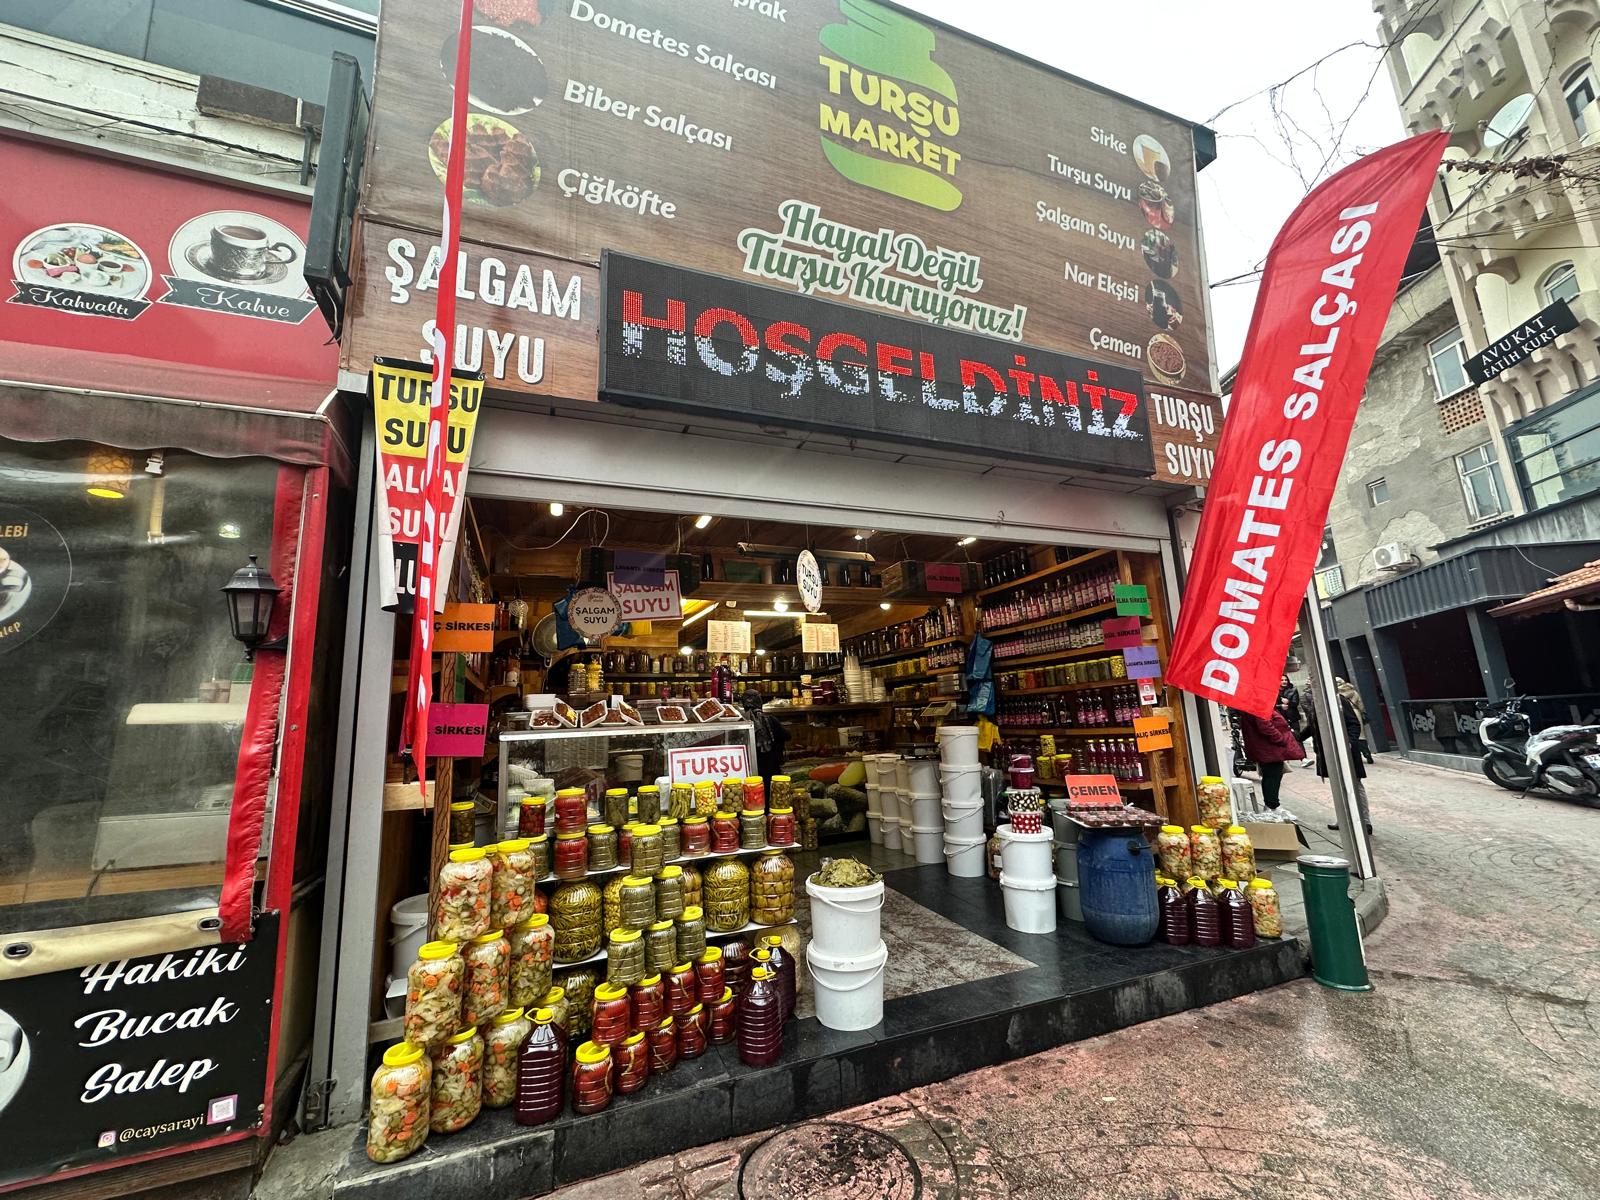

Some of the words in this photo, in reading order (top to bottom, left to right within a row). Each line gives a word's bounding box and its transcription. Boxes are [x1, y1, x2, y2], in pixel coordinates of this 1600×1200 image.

[731, 0, 787, 23] prak
[569, 0, 690, 58] Dometes
[694, 43, 777, 90] Salçası
[563, 79, 640, 121] Biber
[643, 105, 733, 151] Salçası
[818, 55, 960, 137] TURŞU
[819, 103, 961, 177] MARKET
[1090, 126, 1127, 155] Sirke
[557, 168, 677, 219] Çiğköfte
[1047, 153, 1091, 185] Turşu
[1094, 172, 1131, 201] Suyu
[1035, 200, 1095, 237] Şalgam
[1098, 222, 1136, 251] Suyu
[781, 202, 893, 266] Hayal
[896, 235, 981, 293] Değil
[384, 237, 582, 321] ŞALGAM
[740, 230, 846, 294] Turşu
[849, 260, 1025, 340] Kuruyoruz!
[1064, 261, 1094, 288] Nar
[1097, 272, 1140, 304] Ekşisi
[29, 287, 129, 316] Kahvaltı
[197, 287, 290, 317] Kahve
[420, 319, 545, 385] SUYU
[1089, 327, 1142, 359] Çemen
[1480, 316, 1546, 366] AVUKAT
[1483, 350, 1521, 378] FATİH
[1521, 325, 1559, 355] KURT
[622, 289, 1143, 441] HOŞGELDİNİZ
[384, 418, 466, 454] SUU
[1150, 392, 1215, 443] TURŞU
[1165, 441, 1215, 479] SUYU
[1200, 437, 1302, 698] DOMATES
[1283, 200, 1380, 422] SALÇASI
[0, 523, 28, 537] LEBİ
[388, 506, 455, 542] SUU
[802, 563, 818, 588] TURŞU
[803, 579, 817, 599] SUYU
[445, 620, 495, 632] SİRKESİ
[575, 607, 615, 616] ŞALGAM
[583, 616, 608, 624] SUYU
[623, 598, 670, 614] SUYU
[434, 724, 485, 735] SİRKESİ
[677, 755, 743, 778] TURŞU
[1070, 785, 1118, 798] ÇEMEN
[80, 944, 248, 995] Hakiki
[74, 996, 241, 1048] Bucak
[80, 1057, 219, 1104] Salep
[119, 1113, 204, 1142] @caysarayi
